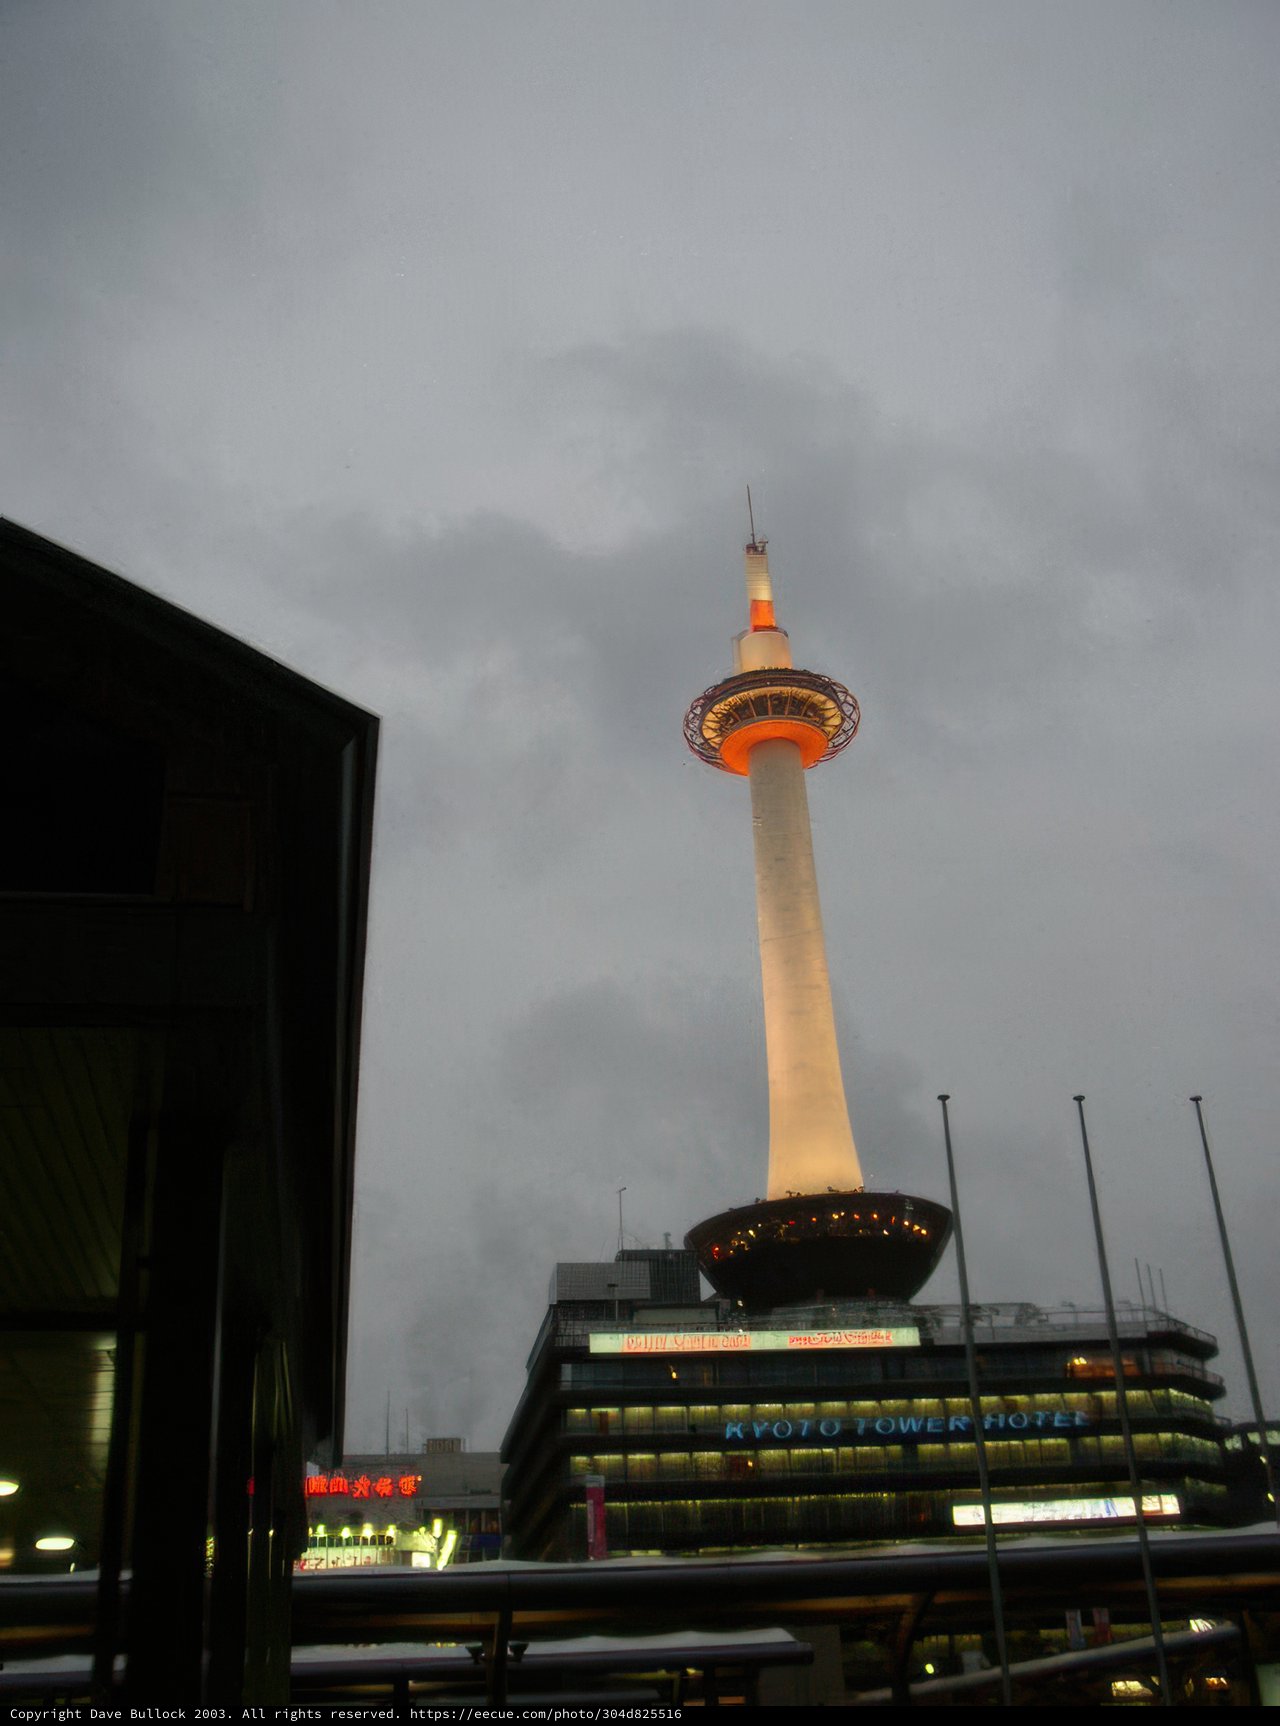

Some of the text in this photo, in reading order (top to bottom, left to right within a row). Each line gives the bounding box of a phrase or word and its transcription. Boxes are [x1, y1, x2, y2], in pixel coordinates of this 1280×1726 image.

[725, 1411, 1089, 1440] KYOTO TOWER HOTEL
